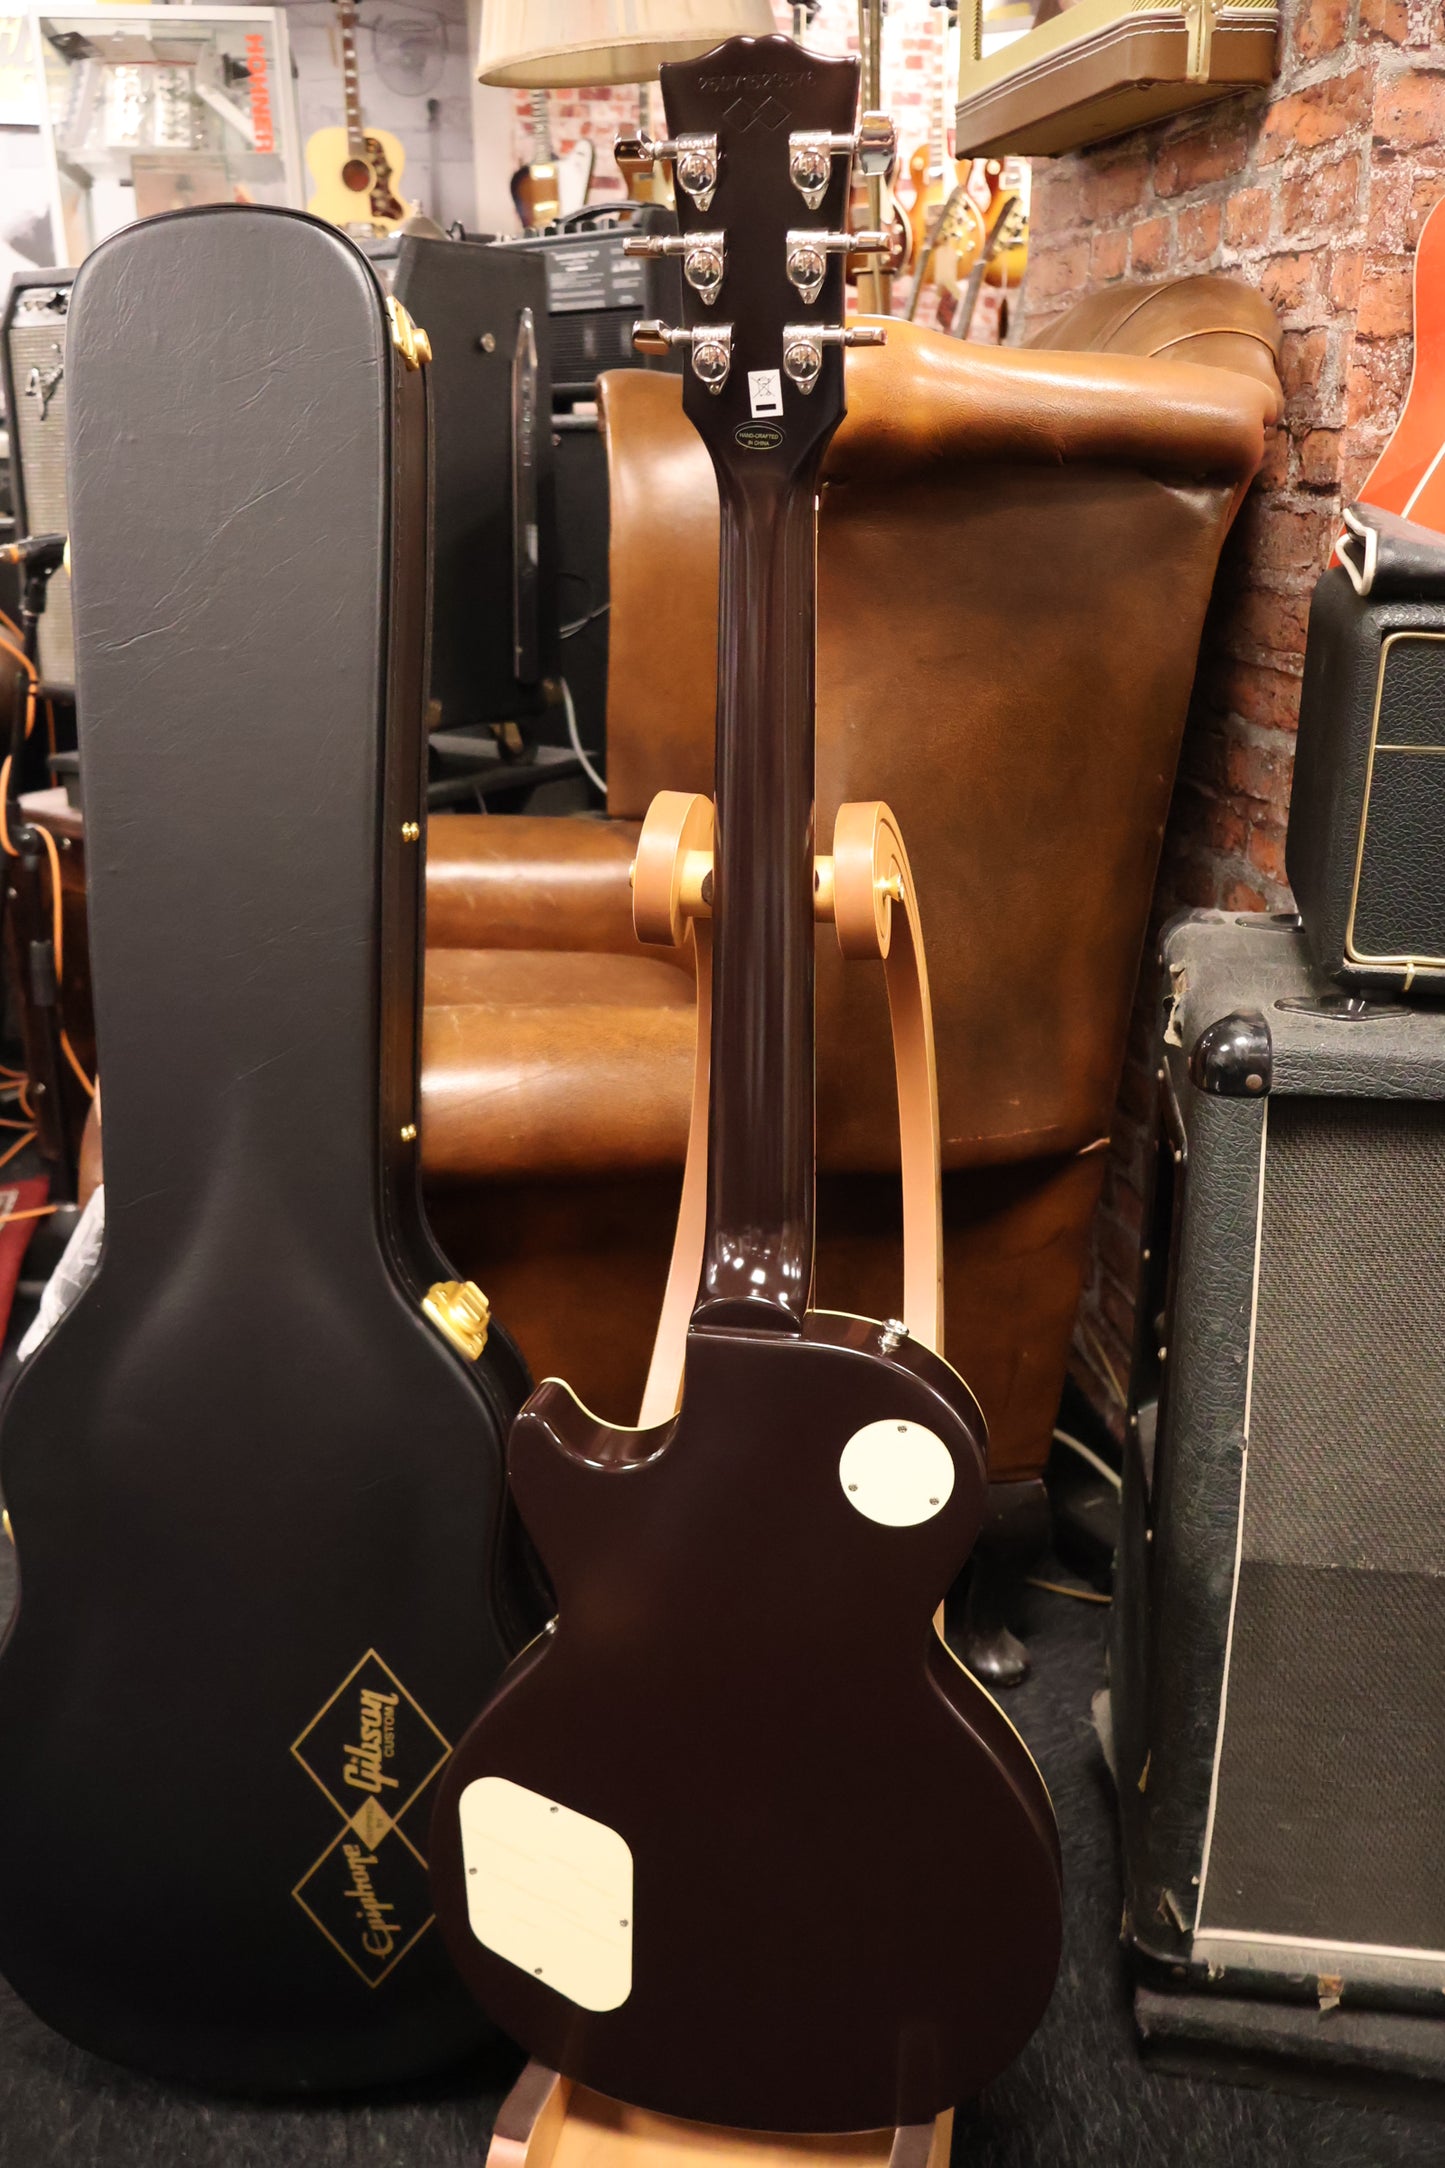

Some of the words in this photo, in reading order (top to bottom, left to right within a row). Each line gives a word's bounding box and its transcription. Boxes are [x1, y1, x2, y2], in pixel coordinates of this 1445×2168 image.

[244, 33, 274, 154] HOHNER
[739, 432, 779, 440] HAND-CRAFTED
[343, 1688, 400, 1794] Gibson
[383, 1704, 395, 1758] CUSTOM
[343, 1844, 402, 1960] Epiphone
